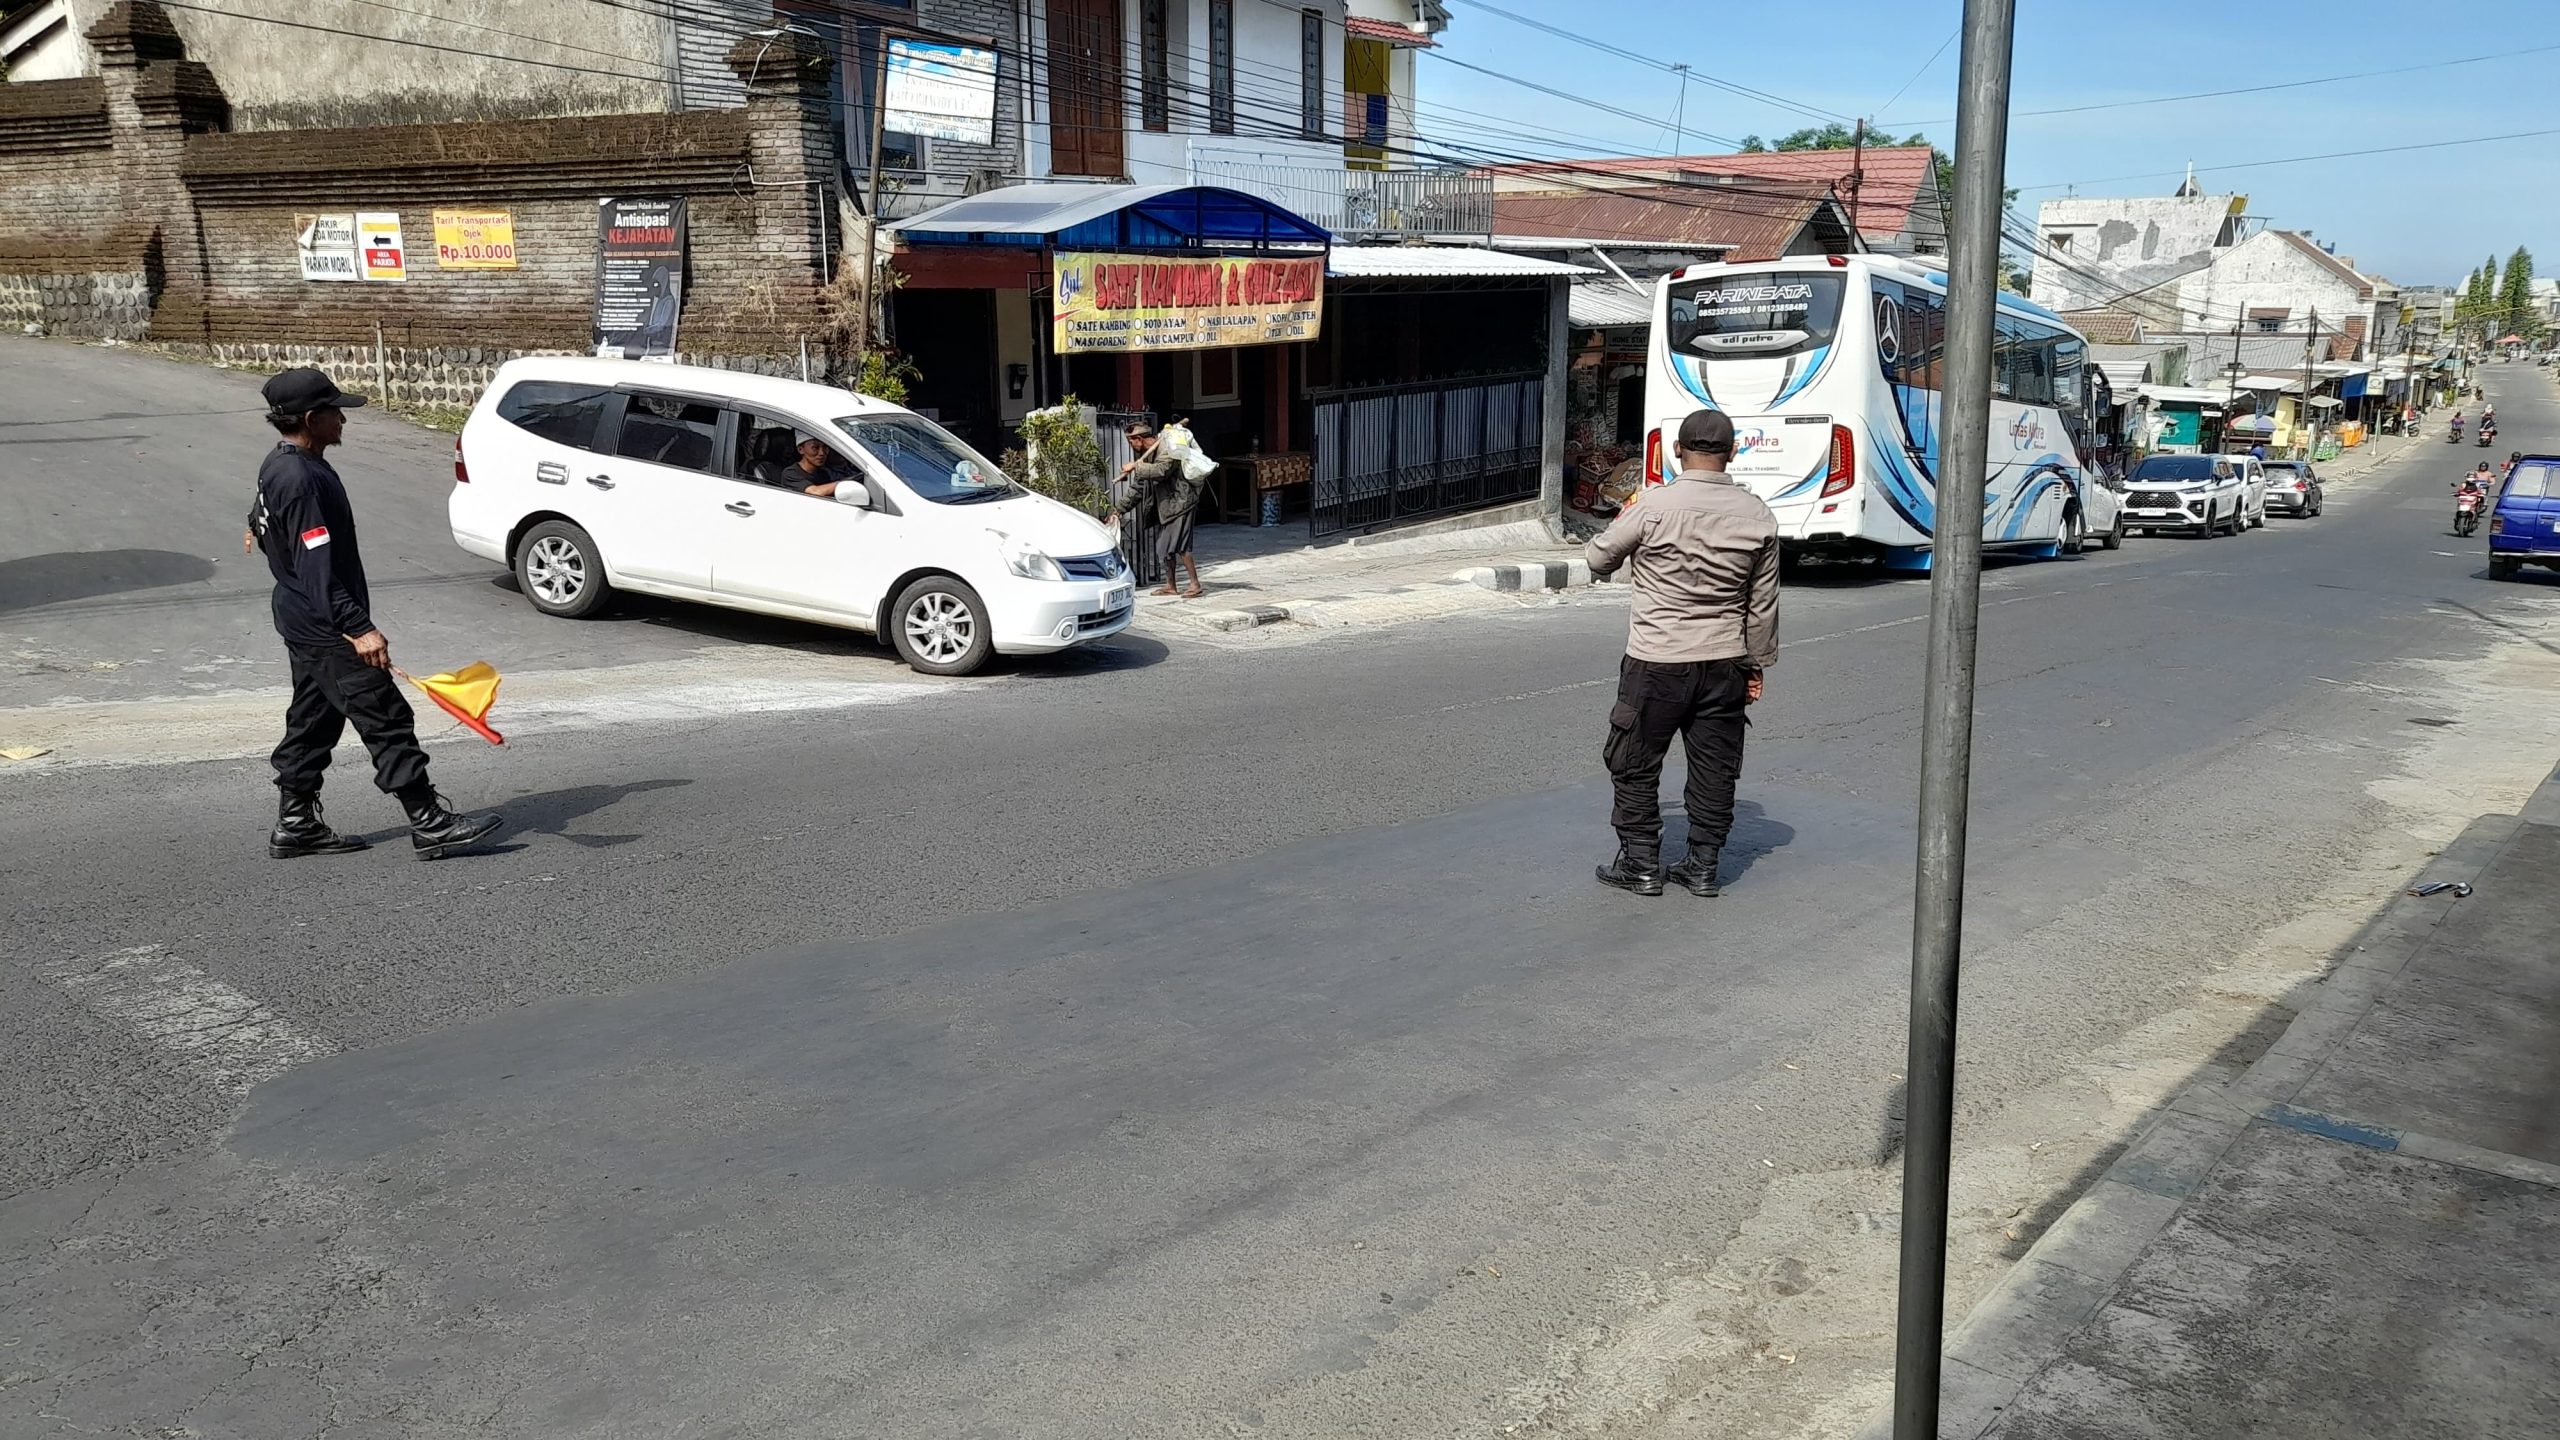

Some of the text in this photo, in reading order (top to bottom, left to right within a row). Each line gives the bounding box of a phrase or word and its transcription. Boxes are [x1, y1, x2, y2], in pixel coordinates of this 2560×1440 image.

[315, 220, 338, 229] ARKIR
[436, 215, 508, 226] Tarif Transportasi
[615, 212, 669, 229] Antisipasi
[327, 231, 351, 241] MOTOR
[463, 229, 482, 239] Ojek
[608, 228, 675, 243] KEJAHATAN
[440, 245, 512, 262] Rp.10.000
[305, 257, 353, 273] PARKIR MOBIL
[373, 258, 396, 266] PARKIR
[1095, 262, 1319, 310] SATE KAMBING & GULE ASLI
[1694, 284, 1813, 305] PARIWISATA
[1207, 315, 1257, 327] NASI LALAPAN
[1272, 313, 1287, 323] KOPI
[1302, 311, 1316, 320] TEH
[1076, 320, 1130, 331] SATE KAMBING
[1143, 318, 1187, 329] SOTO AYAM
[1292, 326, 1305, 335] DLL
[1074, 336, 1127, 347] NASI GORENG
[1143, 333, 1195, 344] NASI CAMPUR
[1206, 332, 1217, 341] DLL
[1742, 335, 1774, 344] putro
[1744, 436, 1779, 446] Mitra
